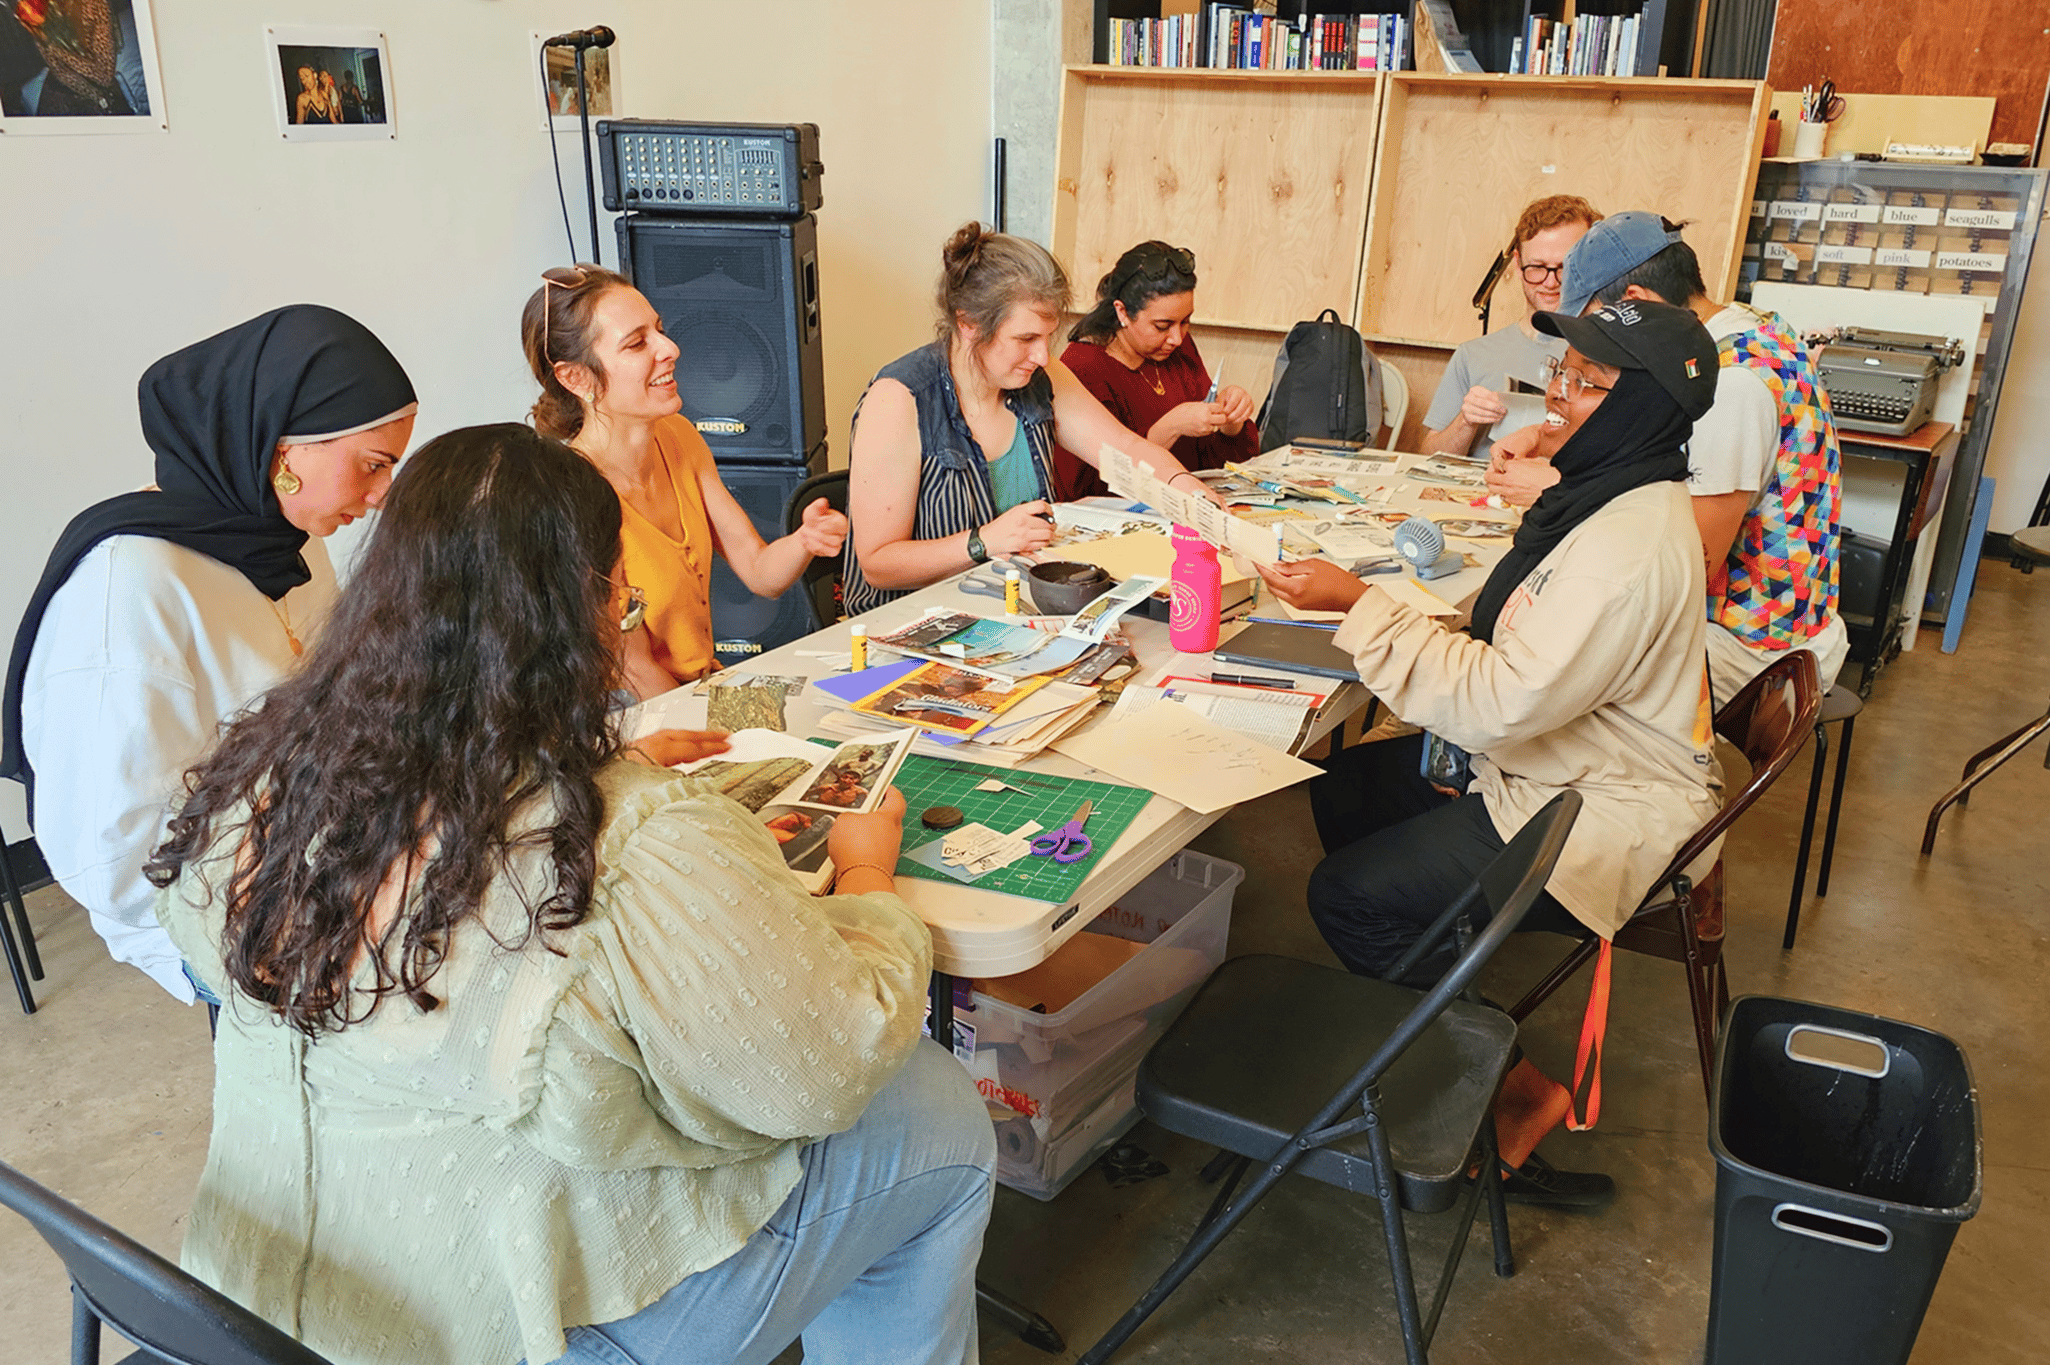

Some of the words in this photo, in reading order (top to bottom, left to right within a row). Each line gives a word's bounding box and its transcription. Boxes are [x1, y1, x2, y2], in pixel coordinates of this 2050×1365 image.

[1776, 205, 1808, 216] loved
[1830, 208, 1858, 219] hard
[1890, 210, 1918, 221] blue
[1949, 215, 2000, 226] seagulls
[1823, 250, 1844, 260] soft
[1883, 252, 1911, 264] pink
[1939, 257, 1993, 268] potatoes
[696, 421, 745, 433] KUSTOM
[715, 643, 762, 653] KUSTOM
[920, 694, 993, 713] Gladiators
